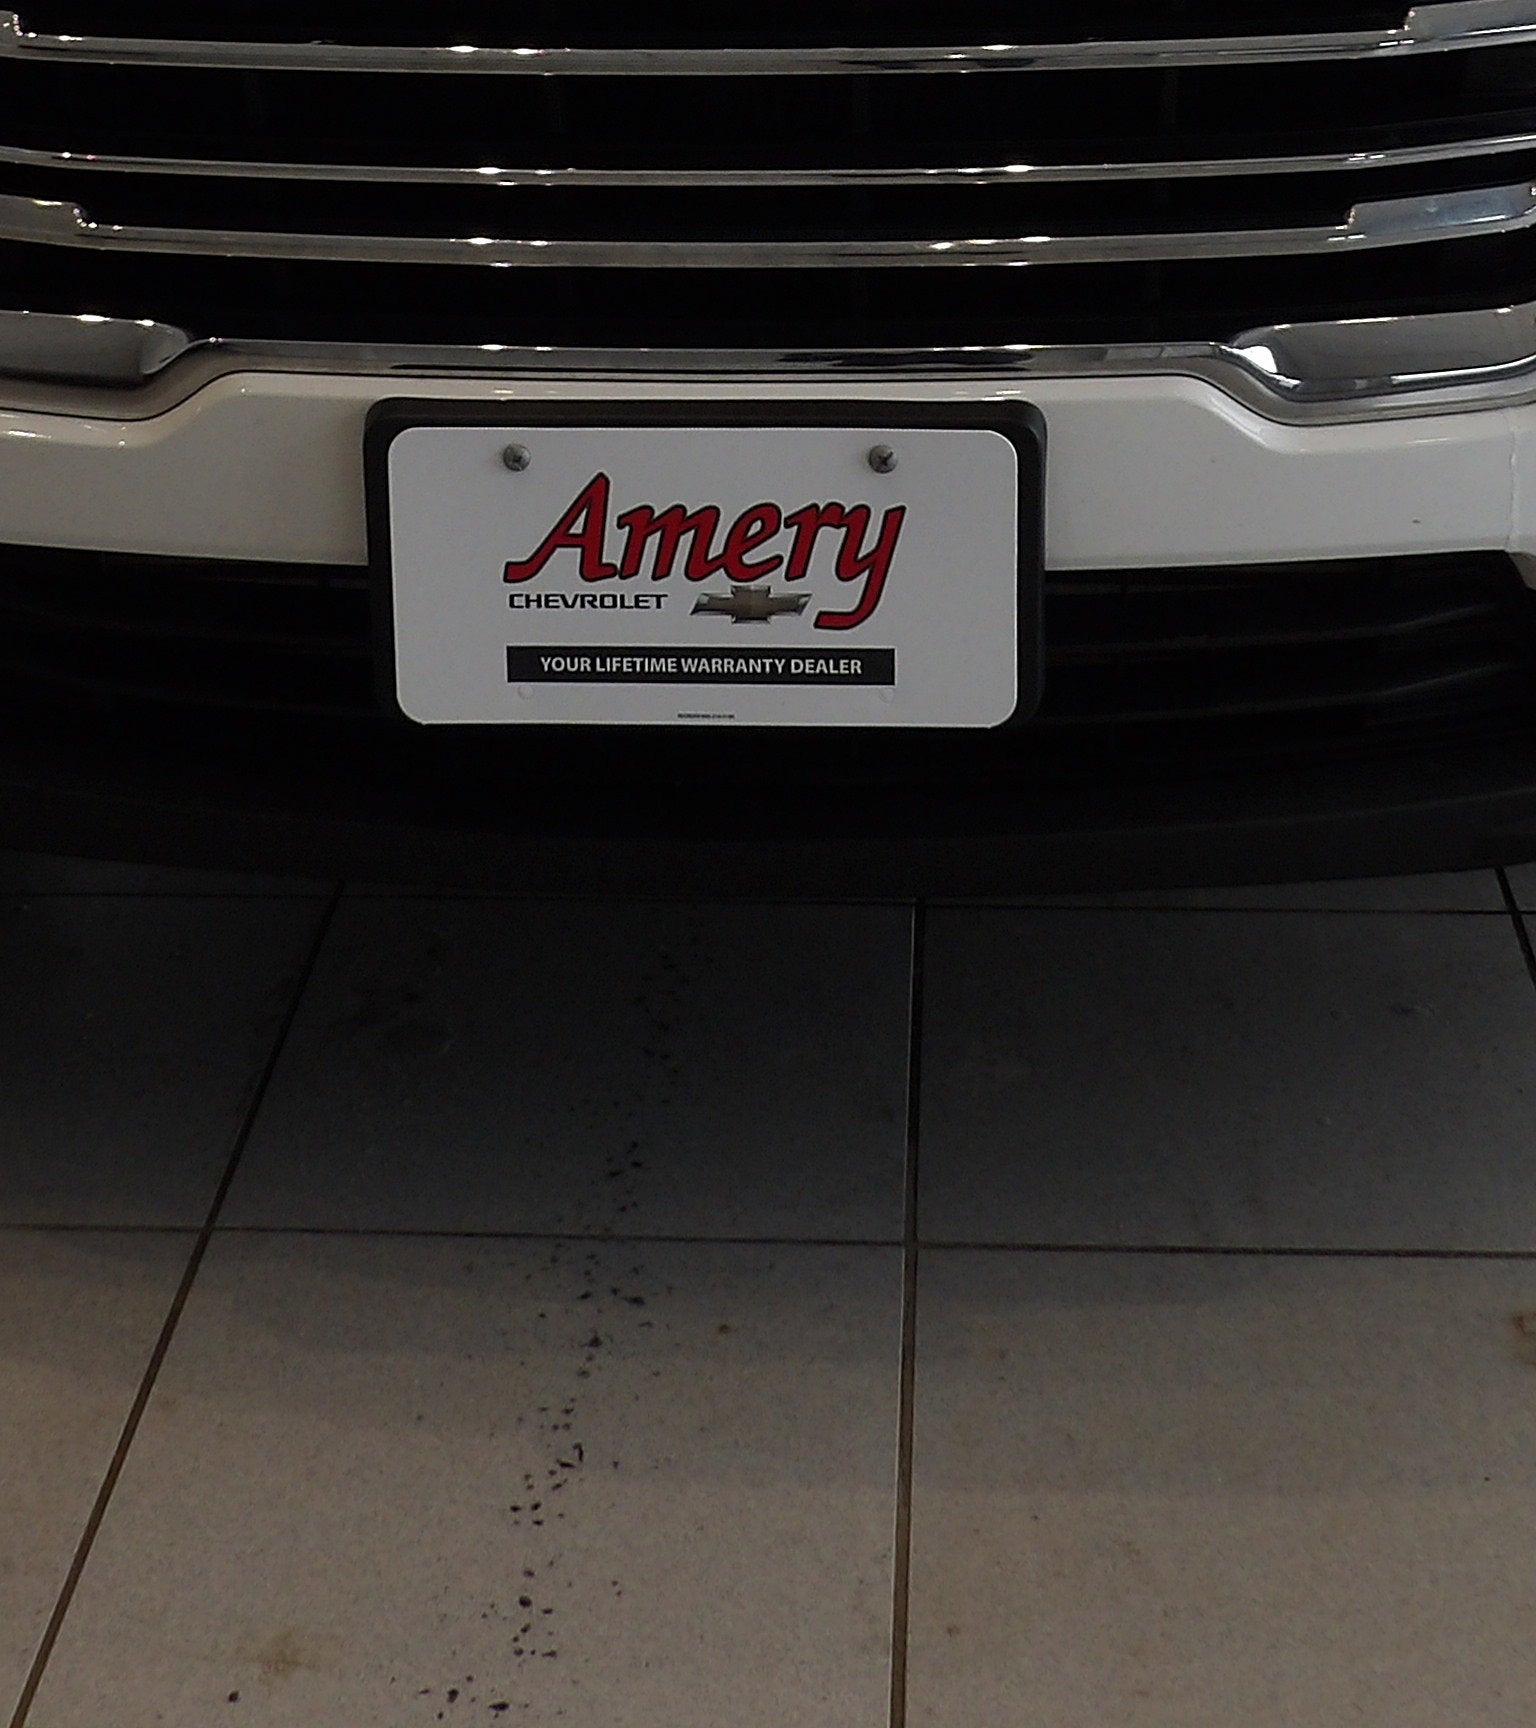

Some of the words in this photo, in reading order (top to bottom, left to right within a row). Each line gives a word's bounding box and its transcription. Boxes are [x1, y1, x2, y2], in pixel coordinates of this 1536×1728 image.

[502, 471, 906, 630] Amery
[509, 593, 668, 610] CHEVROLET
[539, 656, 592, 672] YOUR
[595, 656, 677, 673] LIFETIME
[680, 657, 787, 674] WARRANTY
[790, 658, 863, 674] DEALER
